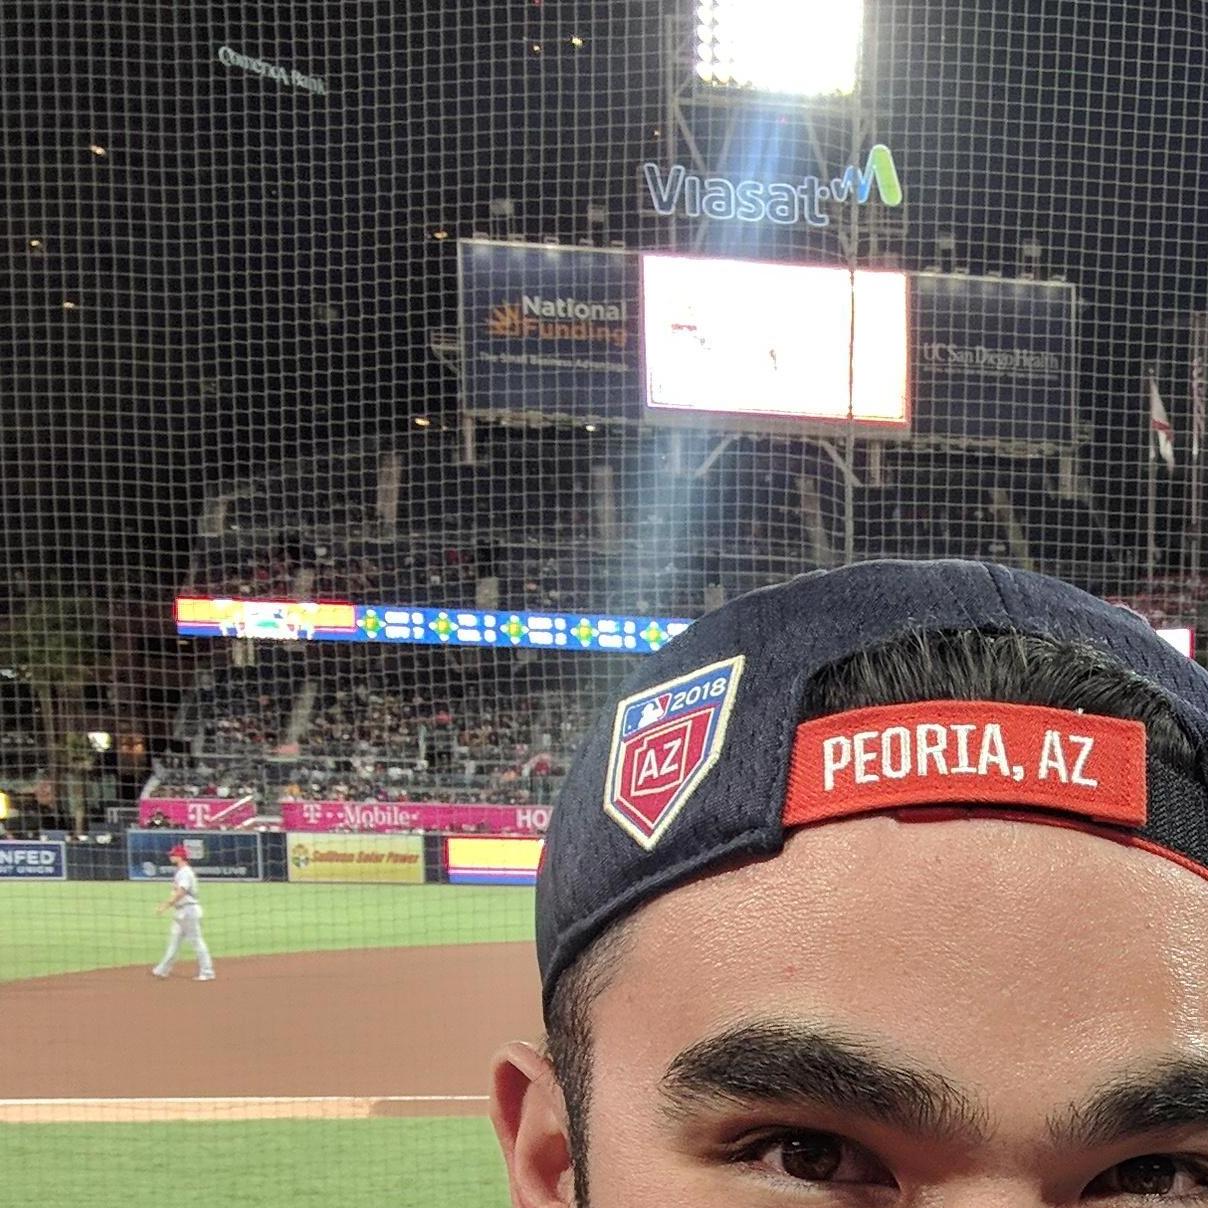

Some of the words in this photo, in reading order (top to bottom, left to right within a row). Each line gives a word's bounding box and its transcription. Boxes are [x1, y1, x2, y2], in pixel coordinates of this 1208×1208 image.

[291, 69, 326, 95] Bank
[644, 163, 829, 226] Viasat
[522, 295, 626, 321] National
[523, 318, 627, 347] Funding
[923, 342, 946, 362] UC
[948, 344, 974, 363] San
[670, 677, 728, 711] 2018
[637, 737, 683, 786] AZ
[822, 723, 1026, 792] PEORIA,
[1038, 729, 1098, 789] AZ
[386, 851, 419, 864] Power
